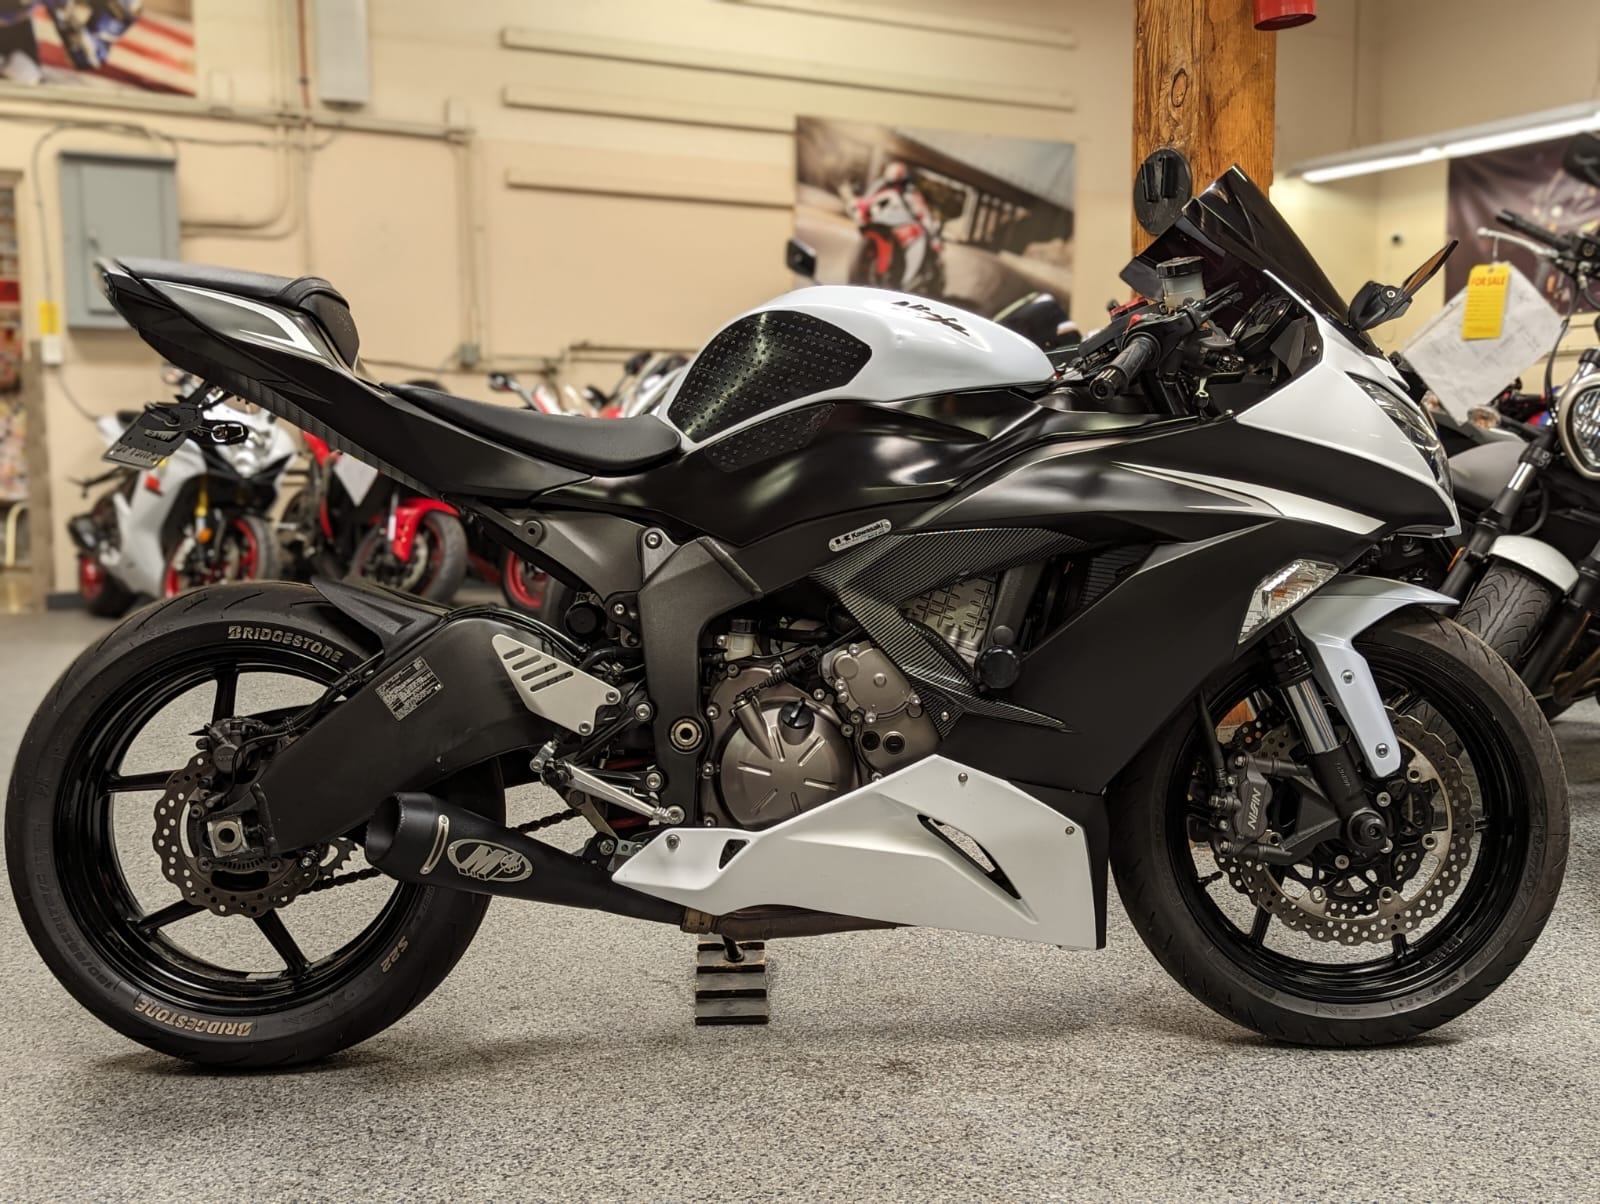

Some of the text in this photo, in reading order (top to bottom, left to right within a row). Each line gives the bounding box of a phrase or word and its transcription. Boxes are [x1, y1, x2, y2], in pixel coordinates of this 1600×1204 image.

[1471, 275, 1506, 286] FOR SALE
[227, 625, 344, 663] BRIDGESTONE
[380, 935, 409, 973] S22
[134, 1000, 254, 1037] BRIDGESTONE
